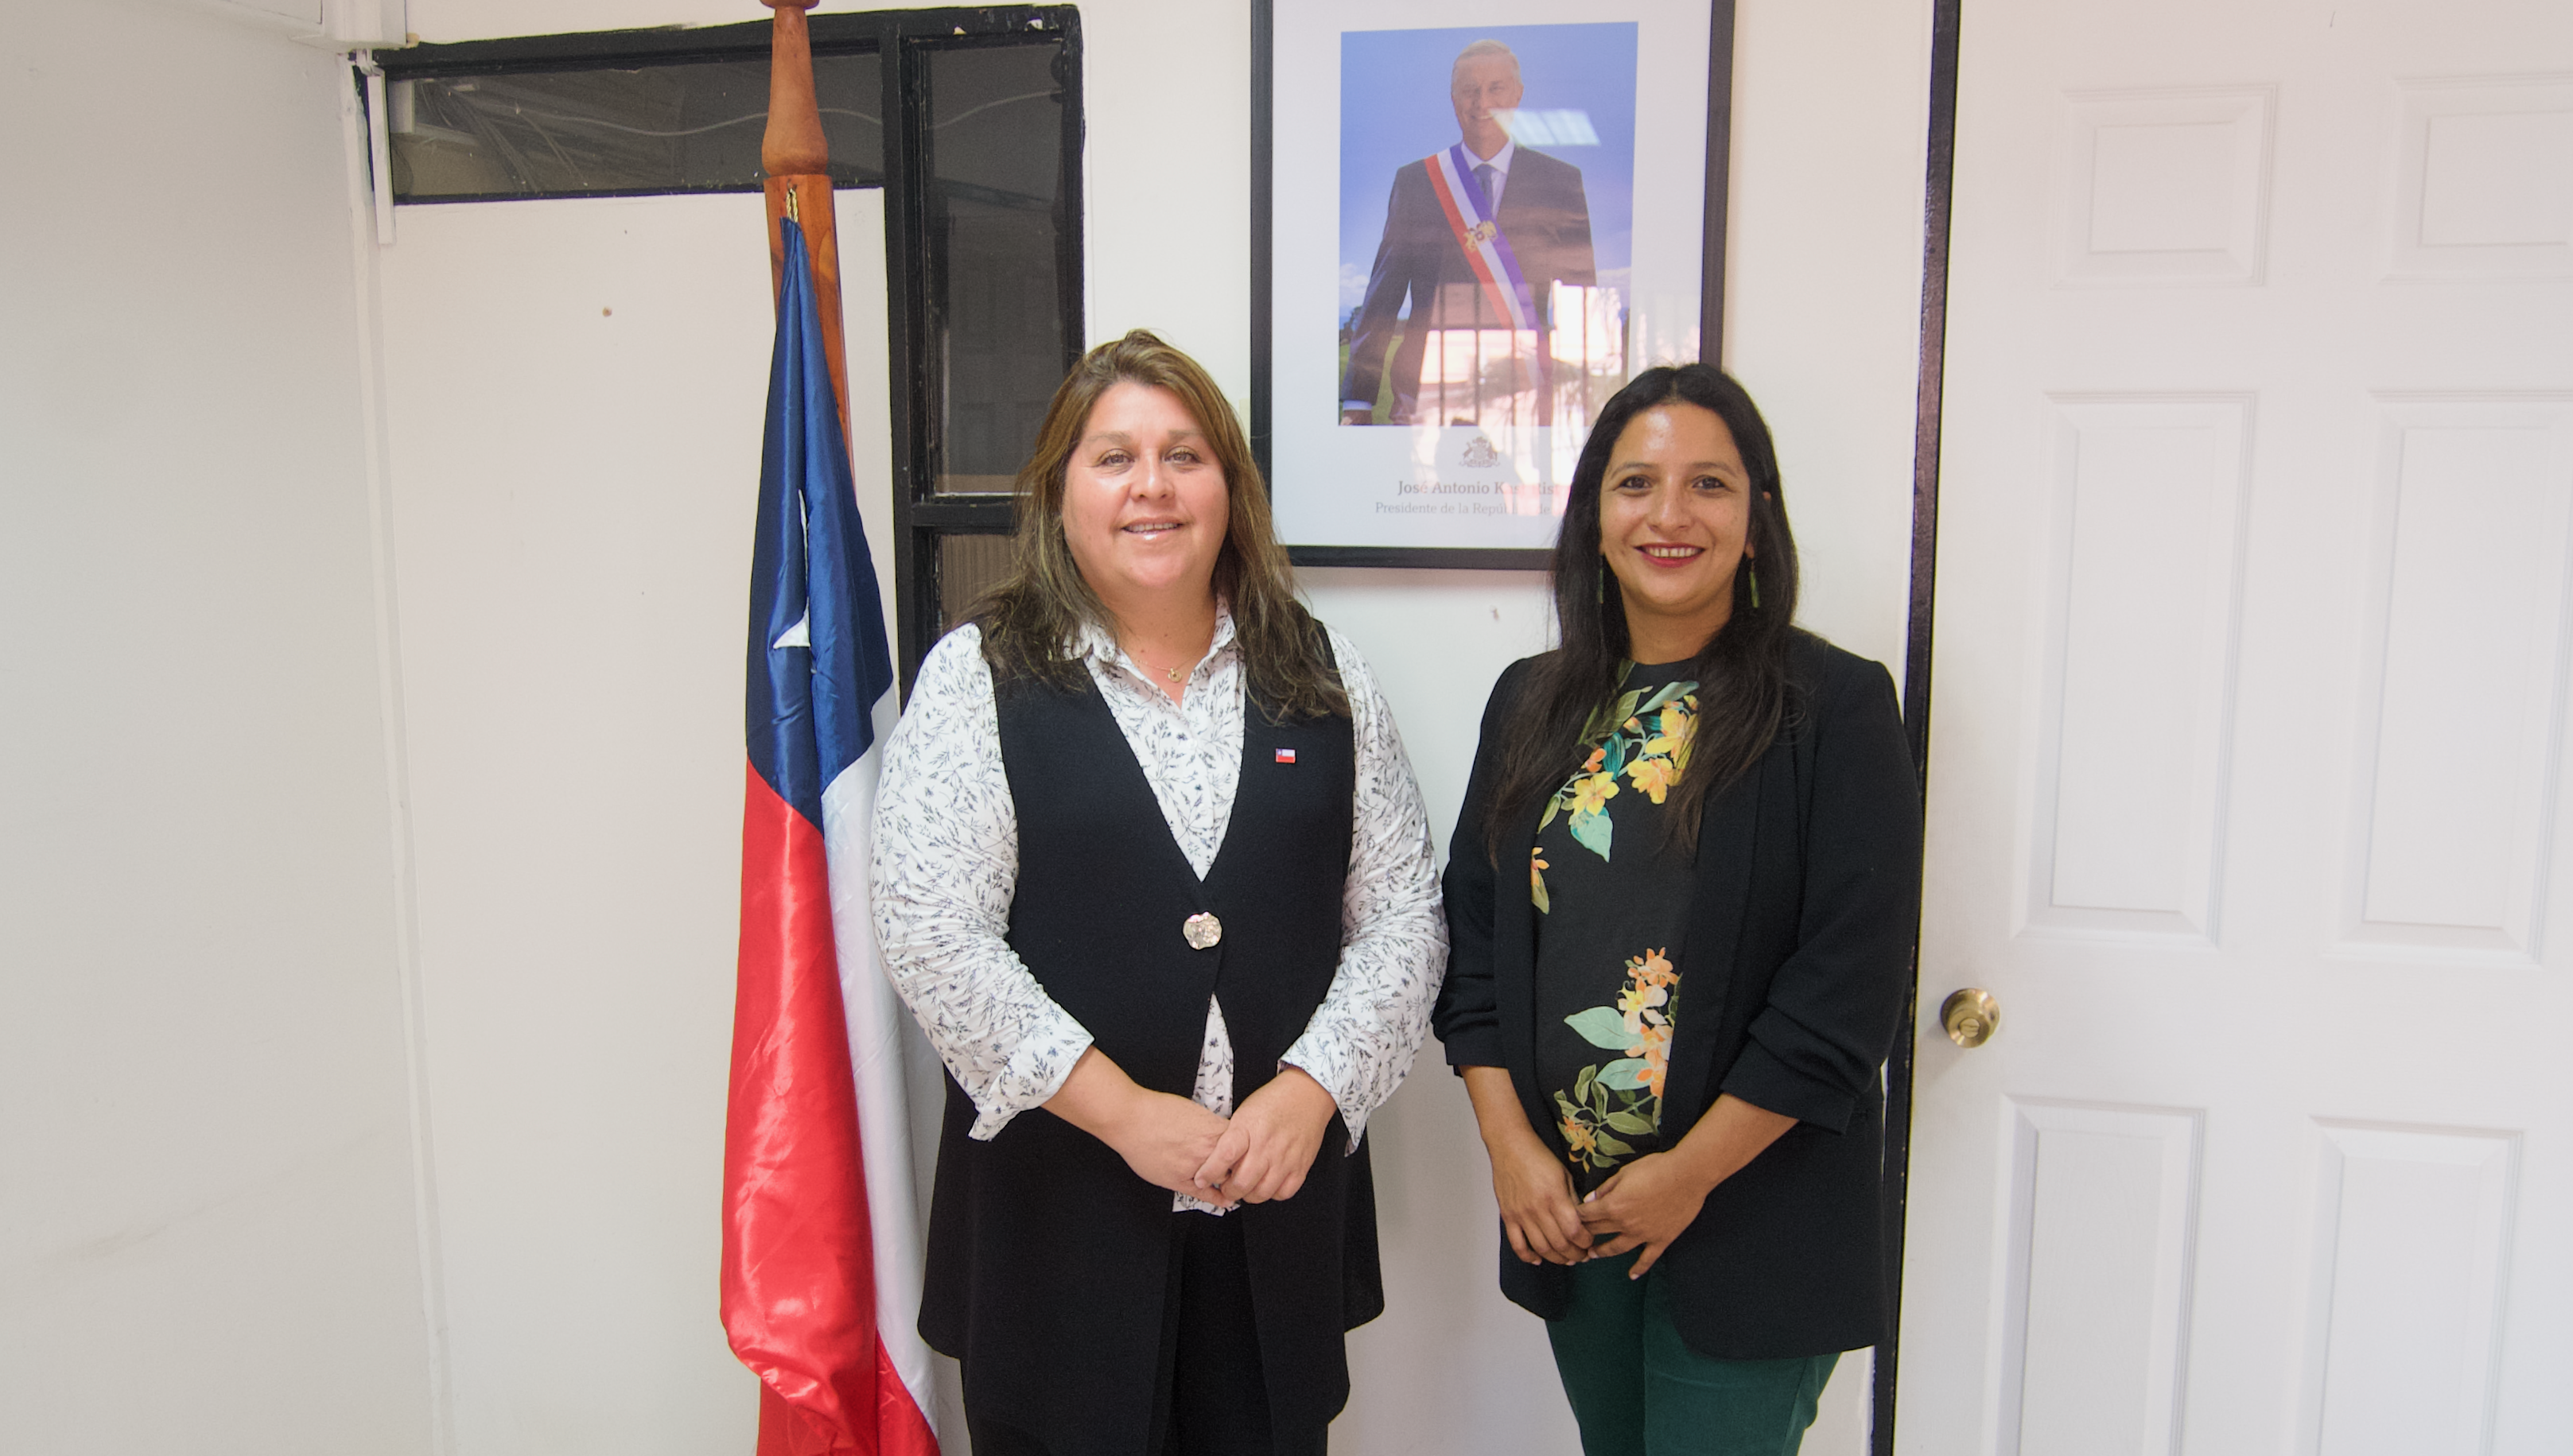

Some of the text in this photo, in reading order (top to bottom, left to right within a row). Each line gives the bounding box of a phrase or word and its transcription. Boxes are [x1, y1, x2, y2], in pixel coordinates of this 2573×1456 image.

[1397, 480, 1428, 495] José
[1432, 481, 1490, 495] Antonio
[1375, 502, 1436, 514] Presidente
[1440, 502, 1455, 514] de
[1458, 503, 1469, 514] la
[1473, 503, 1533, 517] Repúli
